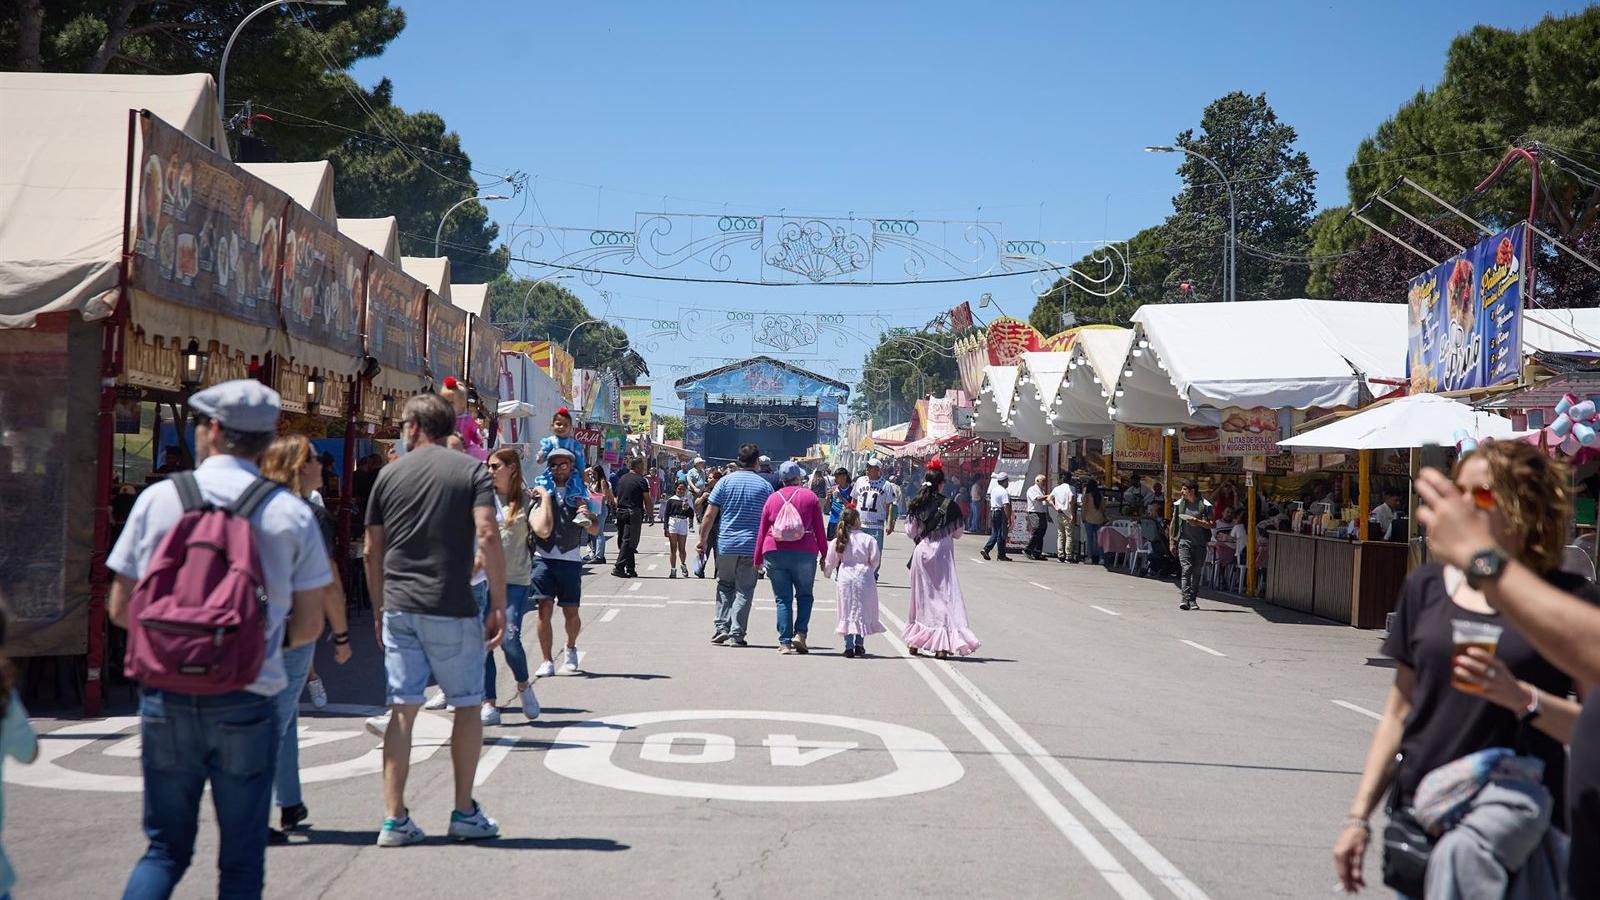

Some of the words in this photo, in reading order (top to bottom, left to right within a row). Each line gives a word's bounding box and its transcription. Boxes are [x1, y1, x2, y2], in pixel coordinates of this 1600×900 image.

[575, 431, 599, 443] CAJA
[1228, 436, 1246, 444] ALITAS
[1246, 436, 1254, 444] DE
[1254, 436, 1272, 444] POLLO
[1115, 450, 1160, 459] SALCHIPAPAS
[860, 492, 878, 512] 11
[639, 732, 859, 767] 40
